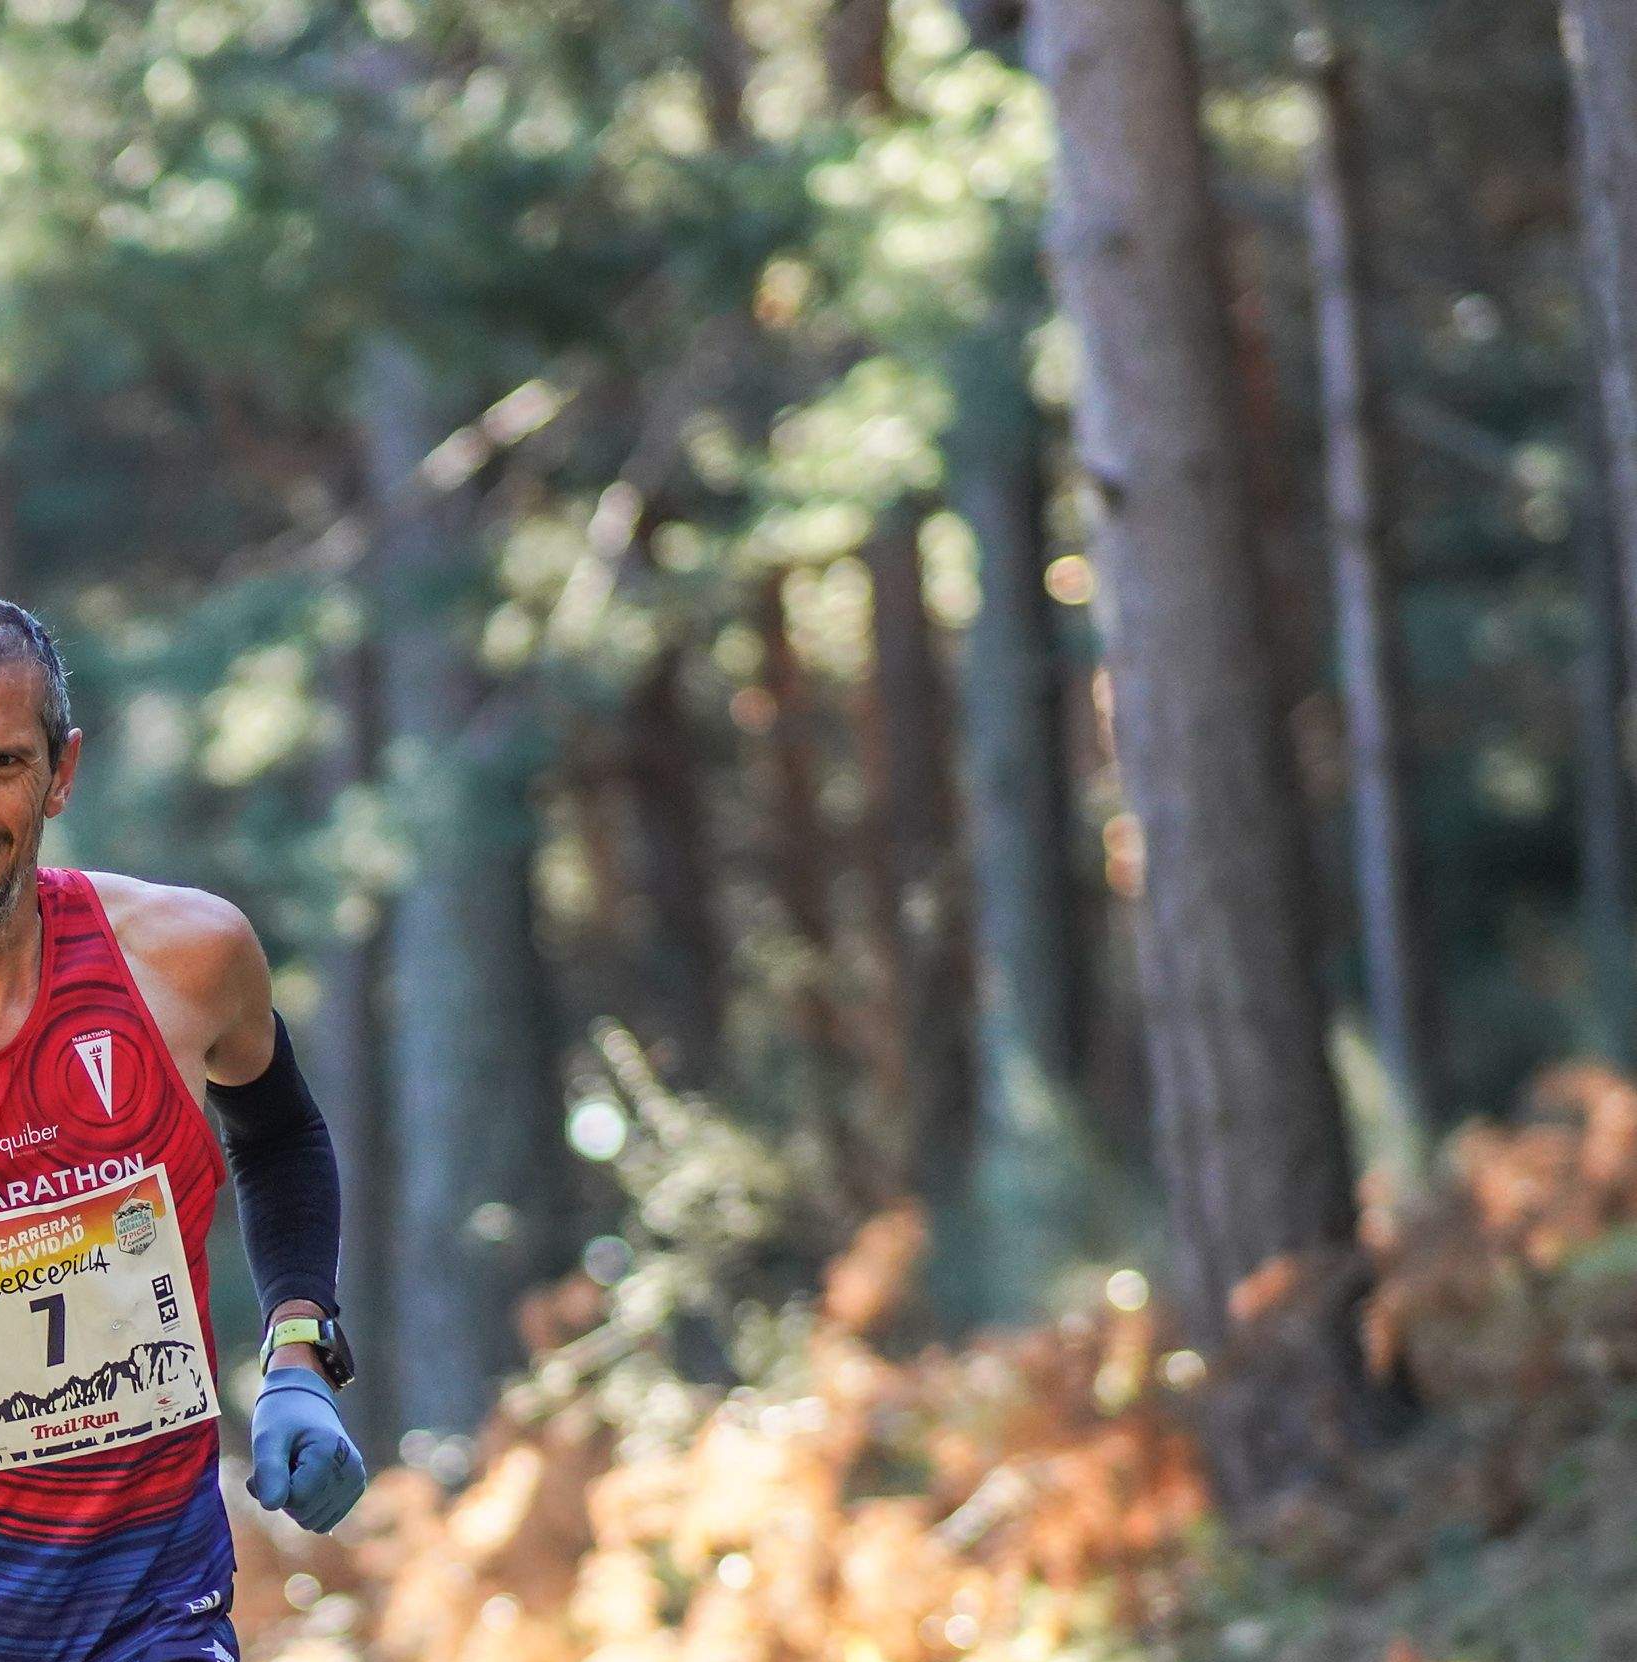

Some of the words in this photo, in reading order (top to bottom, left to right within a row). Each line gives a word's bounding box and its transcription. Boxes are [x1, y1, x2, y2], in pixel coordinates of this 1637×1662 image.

[71, 1029, 111, 1044] MARATHON
[71, 1214, 82, 1224] DE
[0, 1223, 85, 1271] NAVIDAD
[120, 1234, 128, 1246] 7
[128, 1223, 151, 1240] PICOS
[29, 1293, 65, 1367] 7
[30, 1417, 80, 1441] Trail
[78, 1411, 119, 1429] Run
